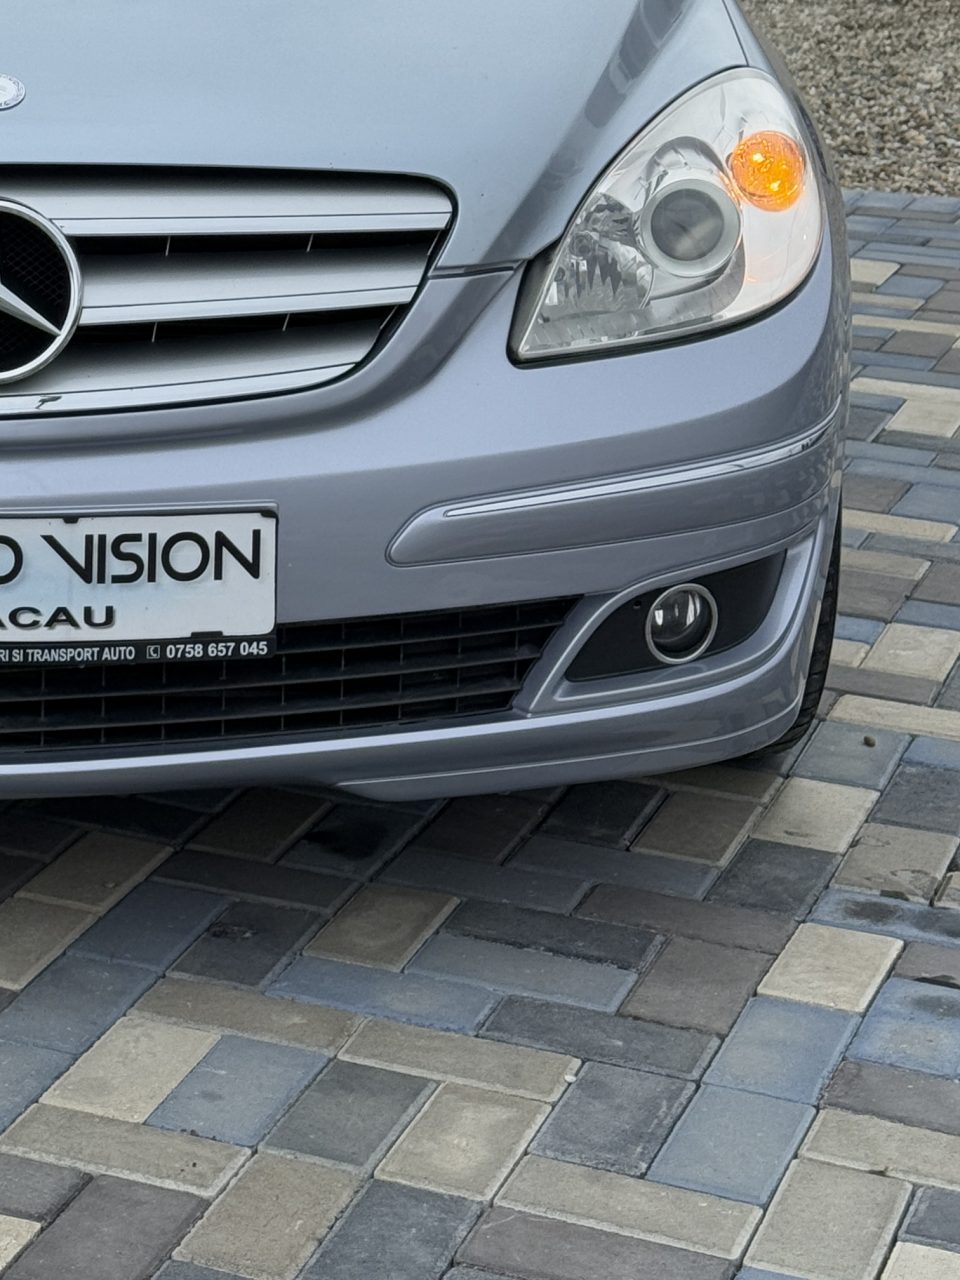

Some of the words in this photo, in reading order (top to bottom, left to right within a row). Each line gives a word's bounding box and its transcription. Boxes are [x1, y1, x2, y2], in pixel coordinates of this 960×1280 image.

[40, 528, 262, 585] VISION
[11, 648, 24, 663] SI
[26, 647, 100, 662] TRANSPORT
[102, 646, 136, 661] AUTO
[166, 643, 203, 659] 0758
[207, 642, 236, 658] 657
[239, 640, 269, 656] 045
